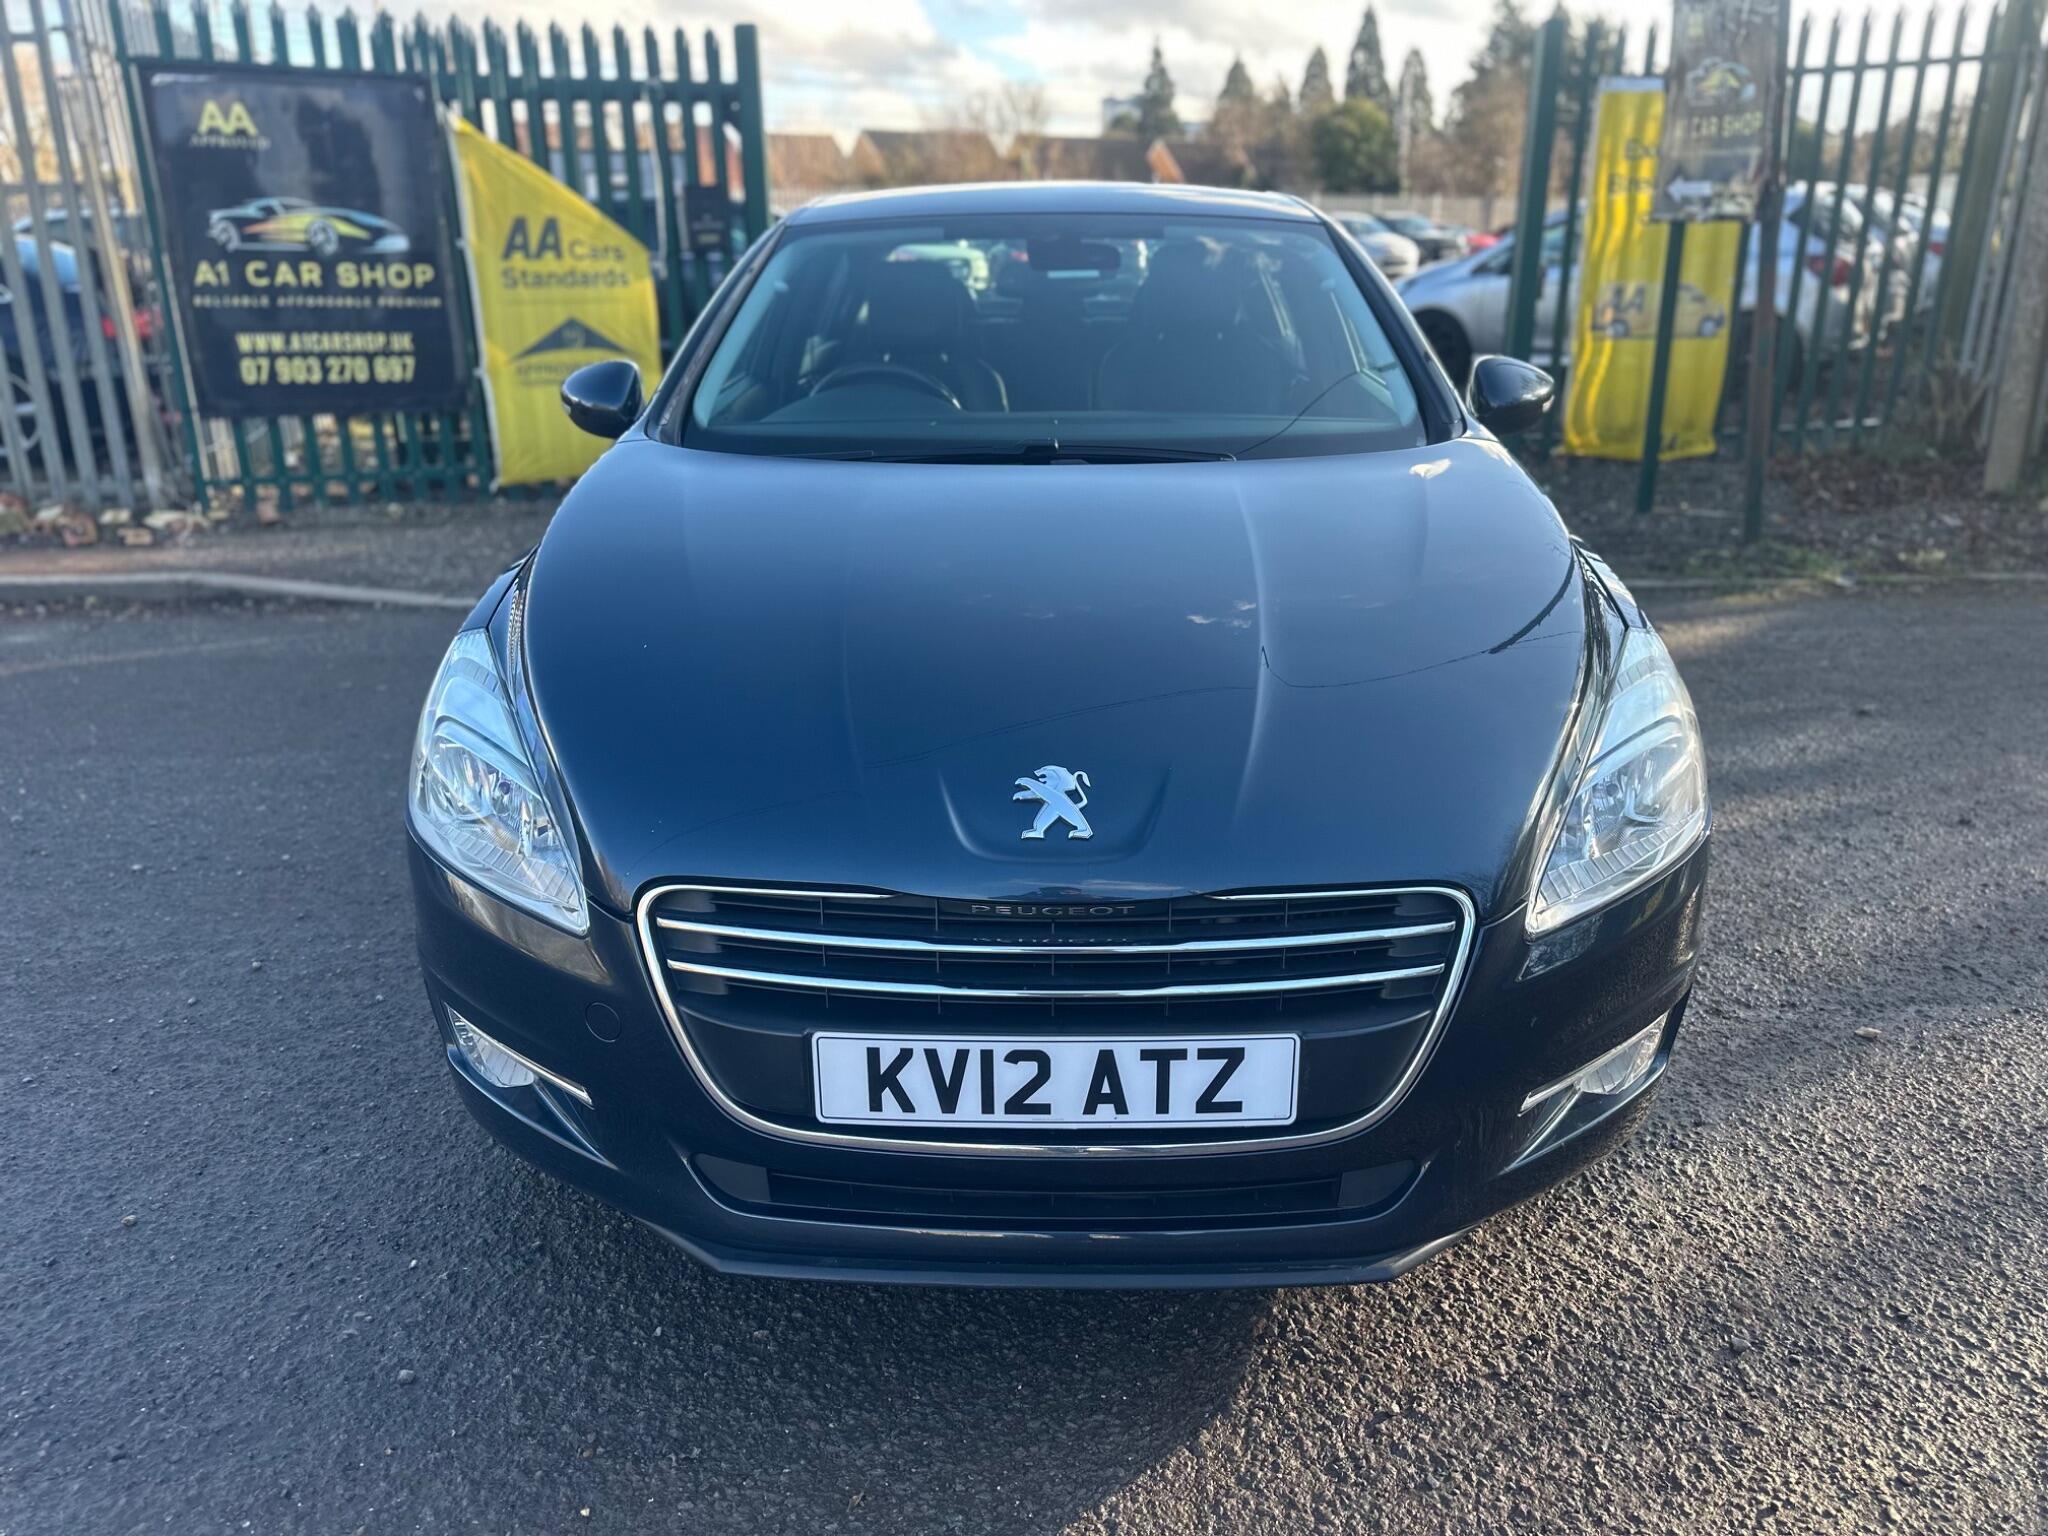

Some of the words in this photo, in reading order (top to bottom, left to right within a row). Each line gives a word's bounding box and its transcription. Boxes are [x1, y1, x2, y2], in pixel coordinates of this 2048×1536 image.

[198, 99, 257, 136] AA
[502, 215, 563, 260] AA
[569, 240, 624, 261] Cars
[193, 259, 231, 288] A1
[245, 260, 323, 288] CAR
[335, 261, 436, 290] SHOP
[502, 267, 630, 289] Standards
[239, 355, 270, 386] 07
[971, 904, 1136, 916] PEUGEOT
[866, 1046, 1052, 1116] KV12
[1082, 1046, 1246, 1116] ATZ
